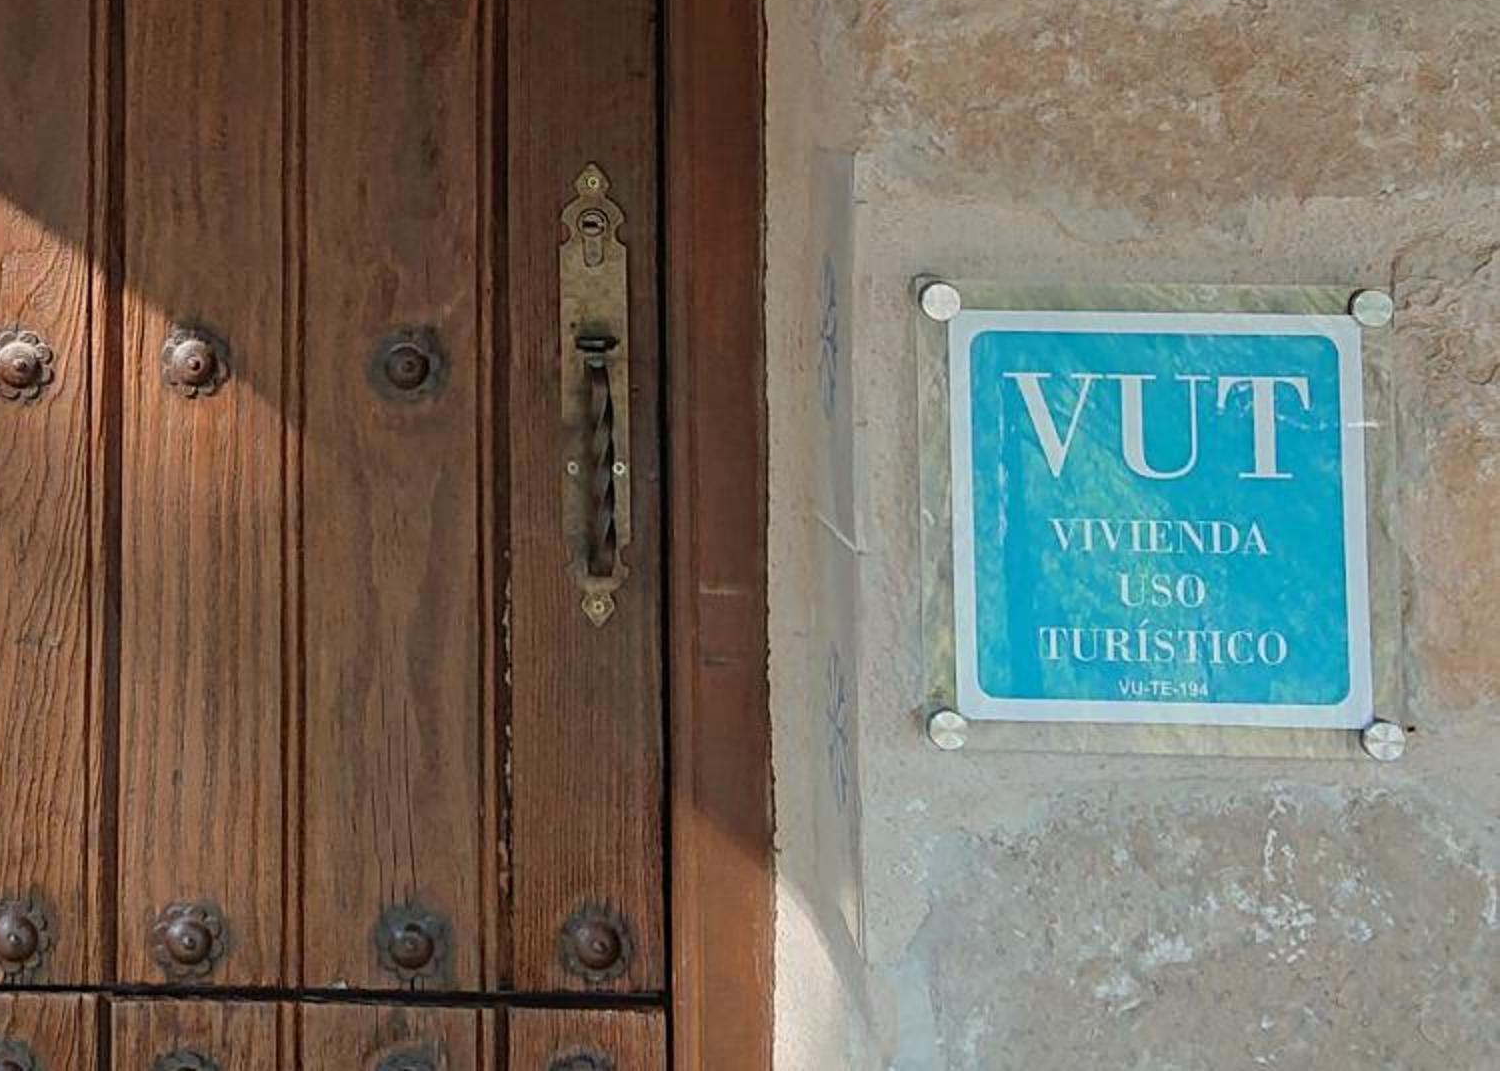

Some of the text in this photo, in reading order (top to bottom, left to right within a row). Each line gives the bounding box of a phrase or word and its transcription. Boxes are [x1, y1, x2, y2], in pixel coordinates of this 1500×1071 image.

[1002, 371, 1312, 480] VUT
[1050, 518, 1270, 556] VIVIENDA
[1119, 574, 1206, 608] USO
[1039, 619, 1288, 666] TURÍSTICO
[1118, 679, 1209, 698] VU-TE-194
